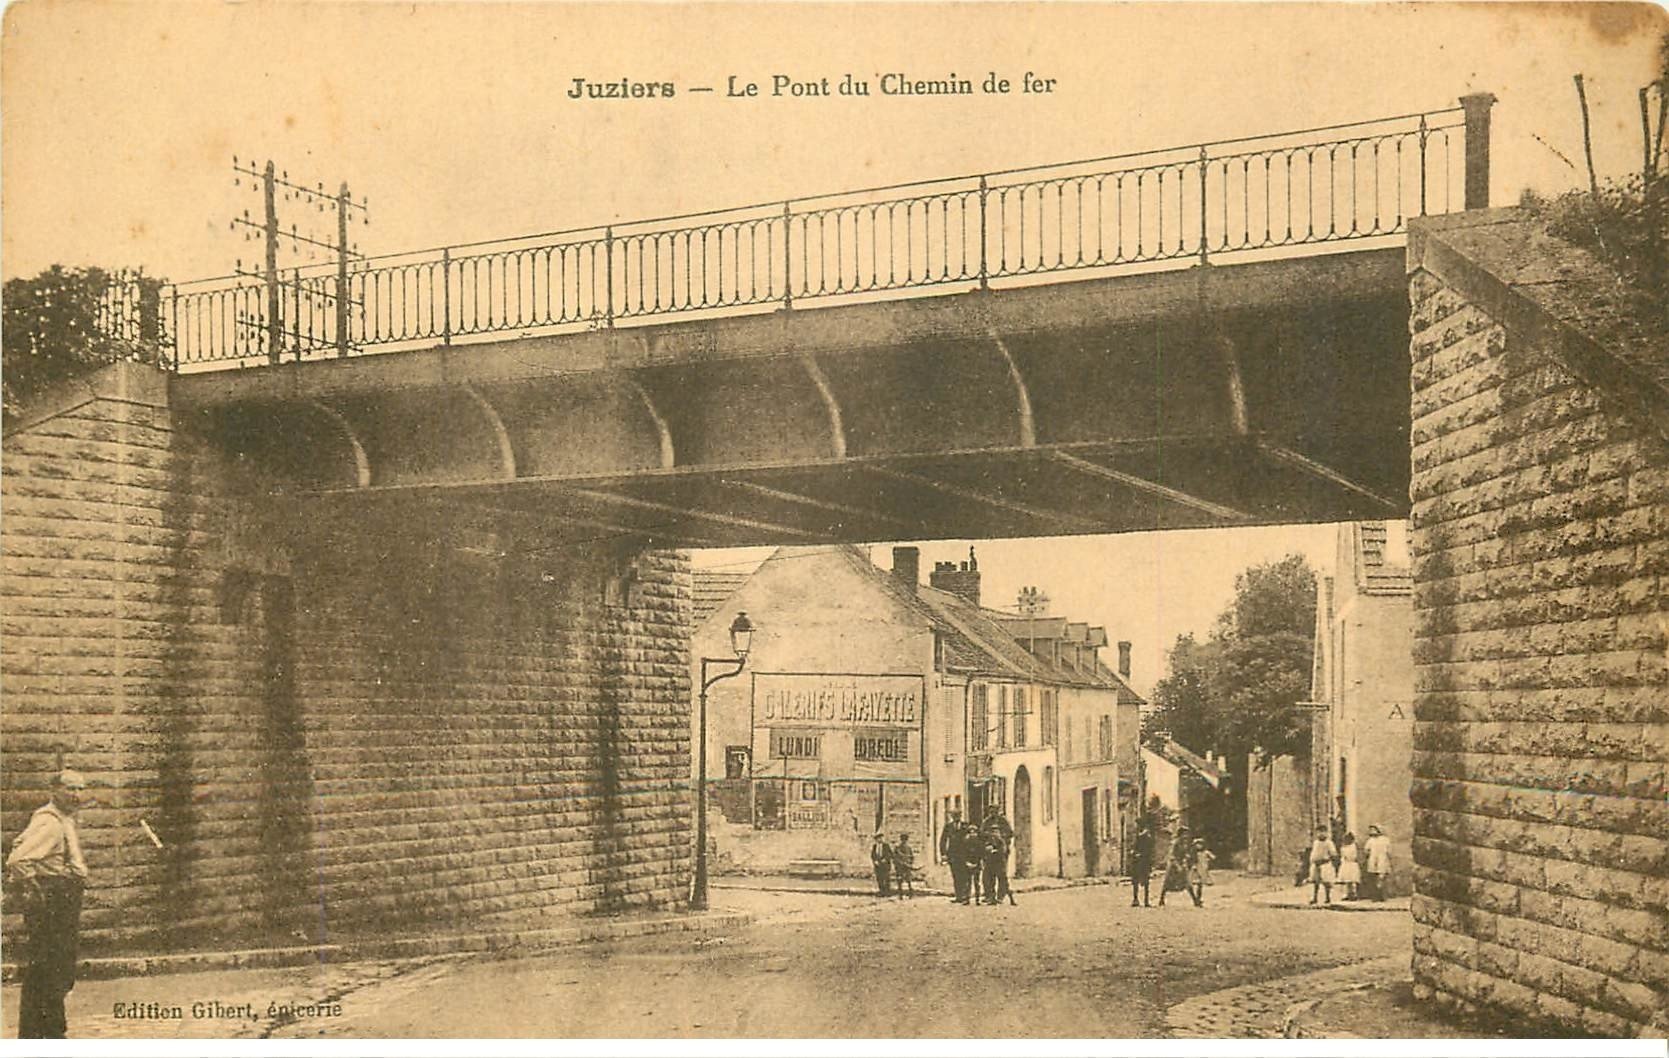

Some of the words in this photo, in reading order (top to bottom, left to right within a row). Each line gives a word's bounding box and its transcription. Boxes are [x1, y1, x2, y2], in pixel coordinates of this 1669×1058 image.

[765, 690, 836, 721] GLERIES
[840, 691, 916, 723] LAFAYETTE
[778, 736, 818, 758] LUNDI
